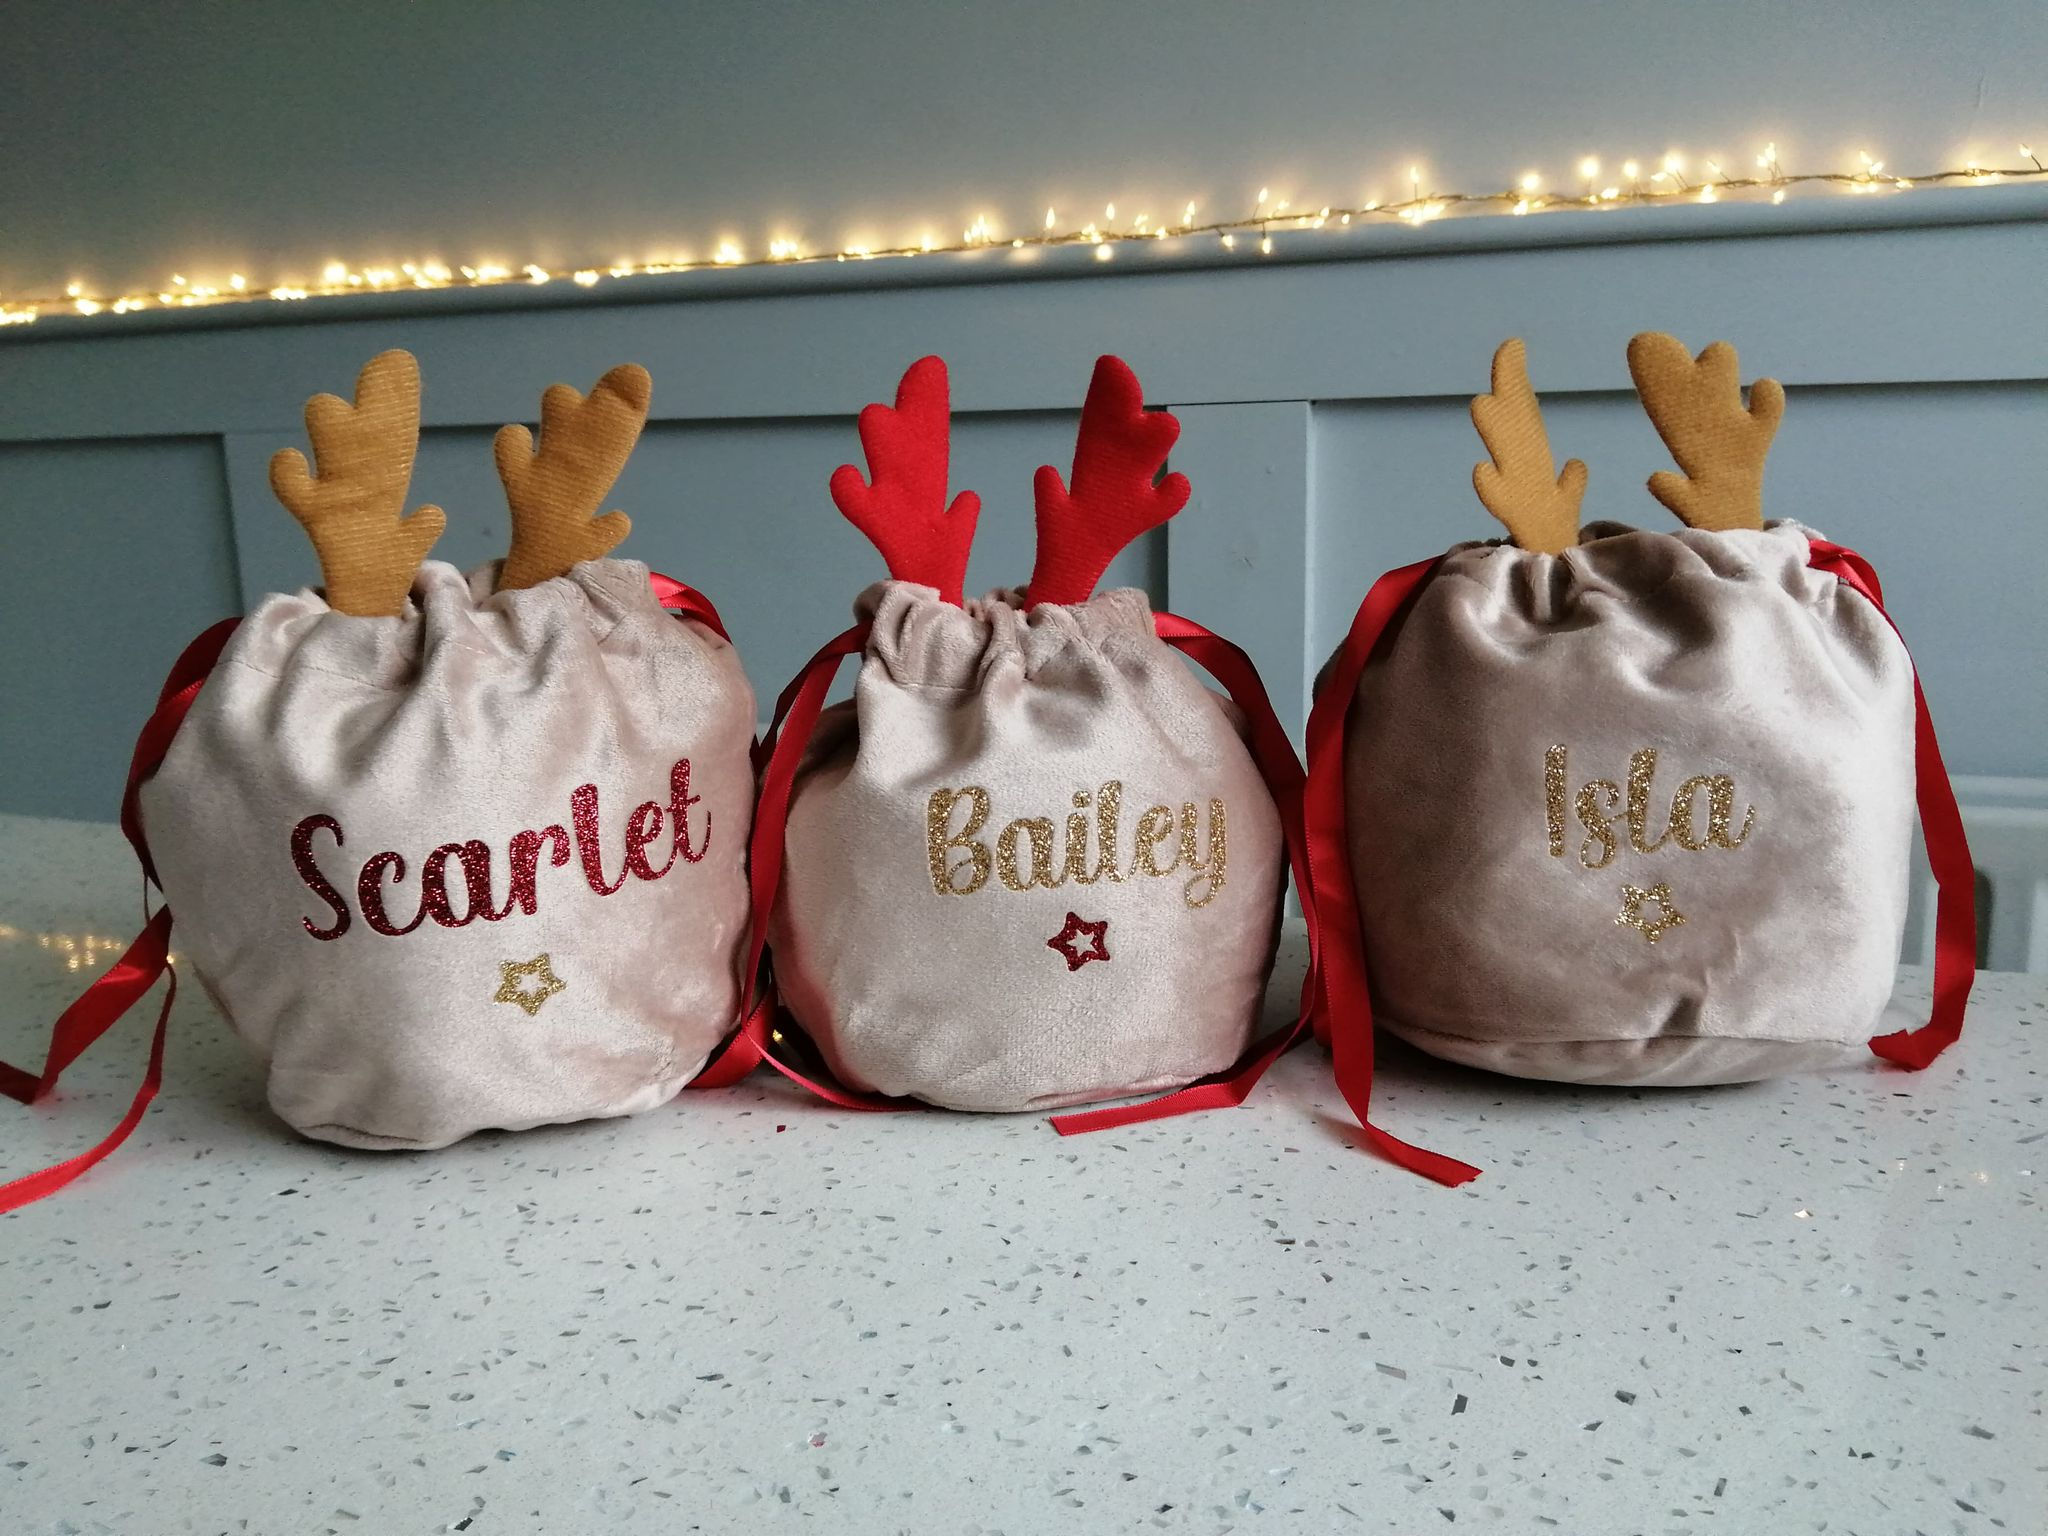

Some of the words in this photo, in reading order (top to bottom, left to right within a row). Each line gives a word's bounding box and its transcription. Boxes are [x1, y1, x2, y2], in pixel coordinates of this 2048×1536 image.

[290, 758, 712, 941] Scarlet
[926, 780, 1228, 909] Bailey
[1544, 743, 1756, 869] Isla
